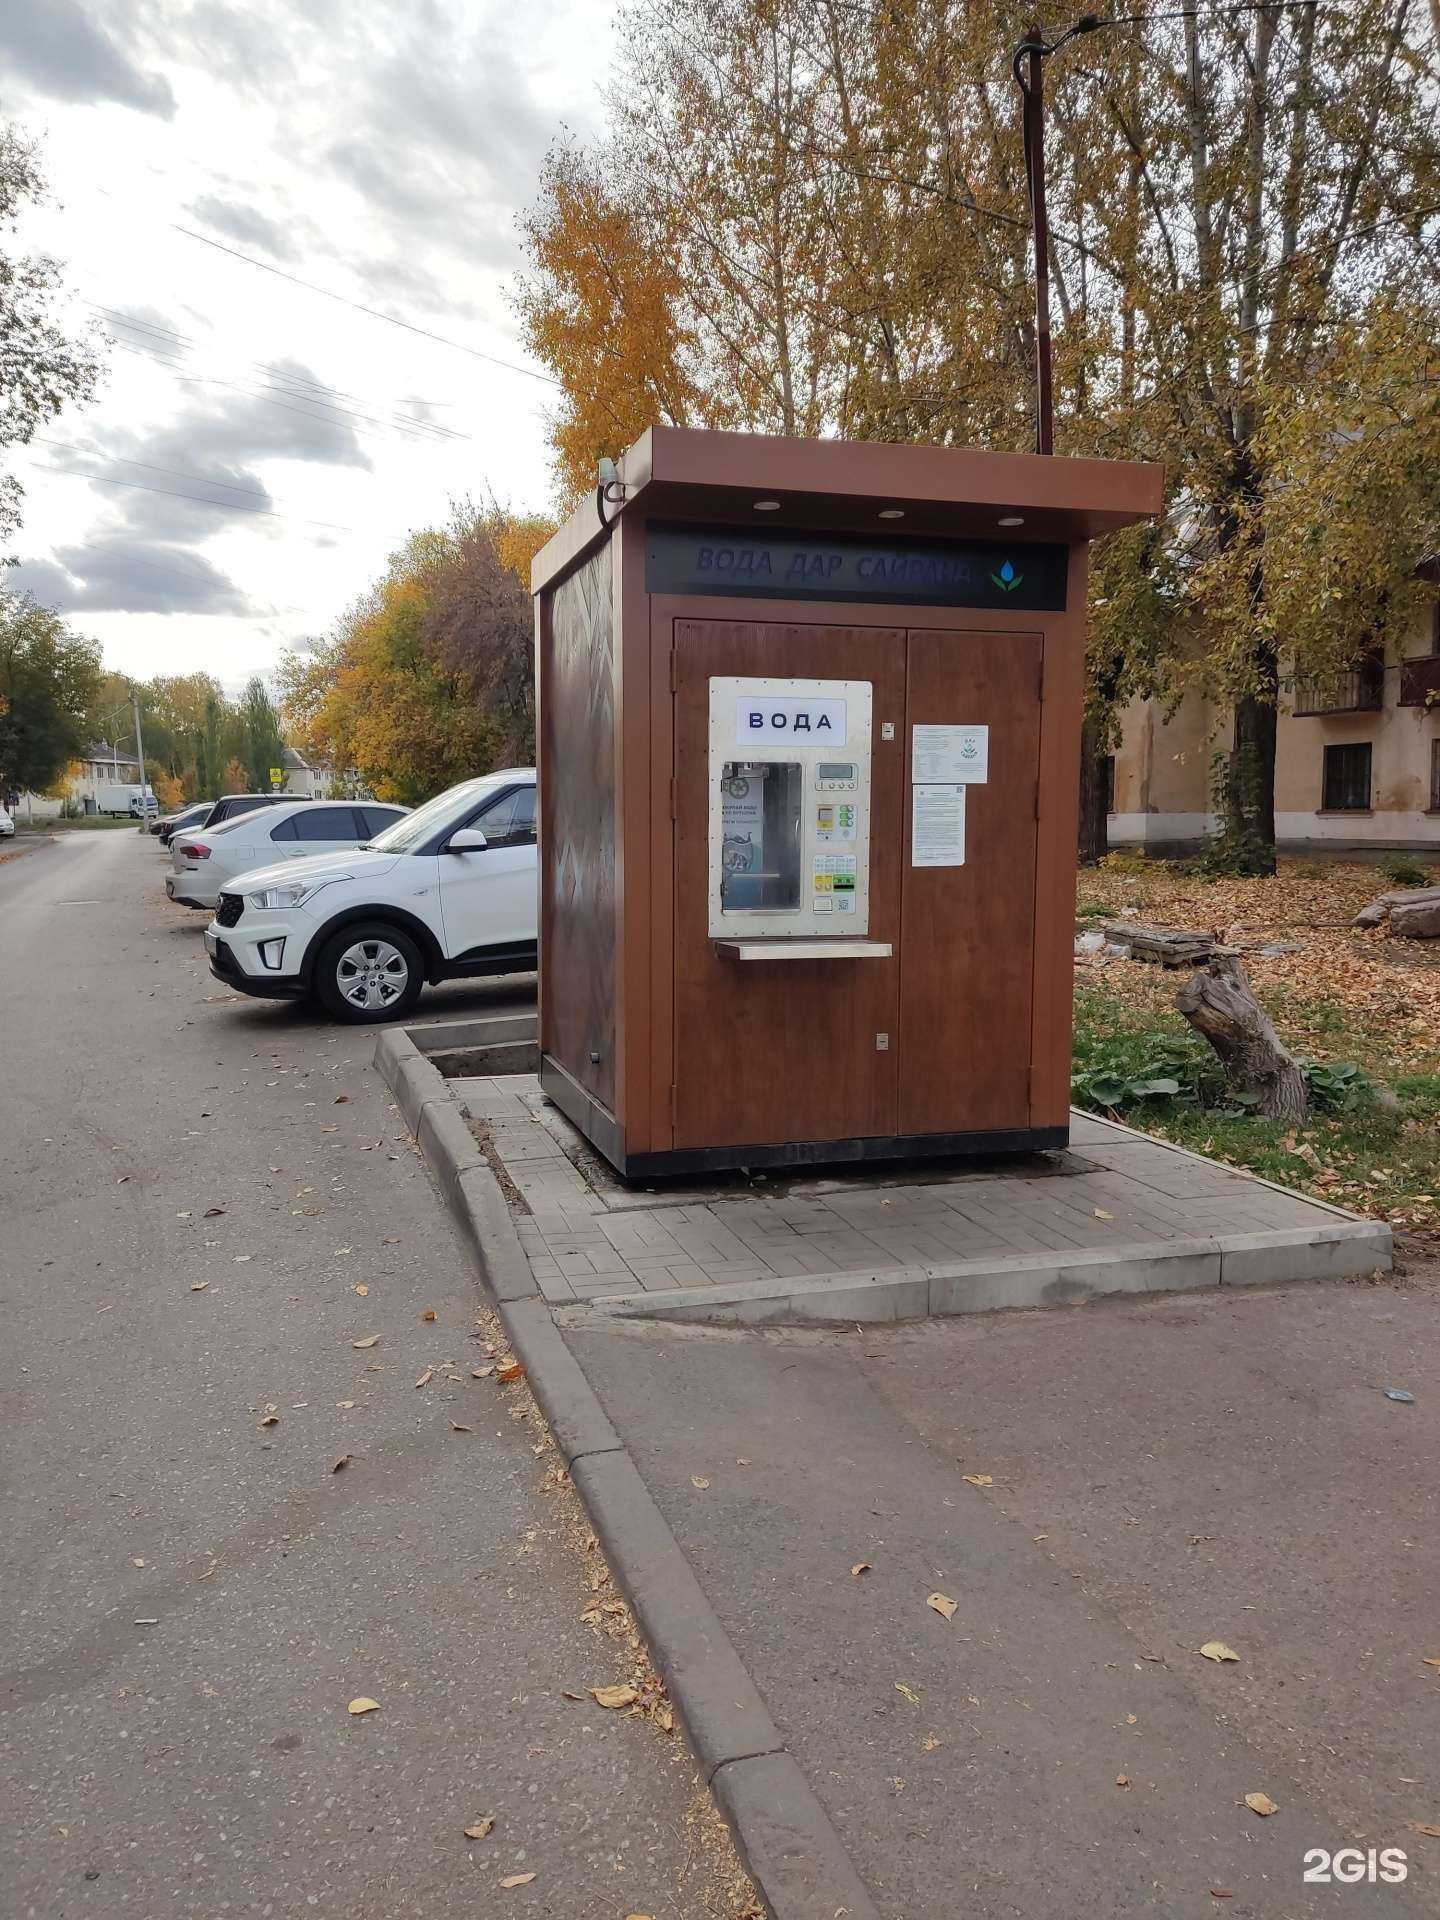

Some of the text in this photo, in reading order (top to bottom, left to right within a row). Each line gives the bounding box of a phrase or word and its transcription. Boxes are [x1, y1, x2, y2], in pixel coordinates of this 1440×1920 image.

[696, 547, 773, 578] ВОДА
[785, 553, 843, 582] ДАР
[749, 712, 832, 732] ВОДА
